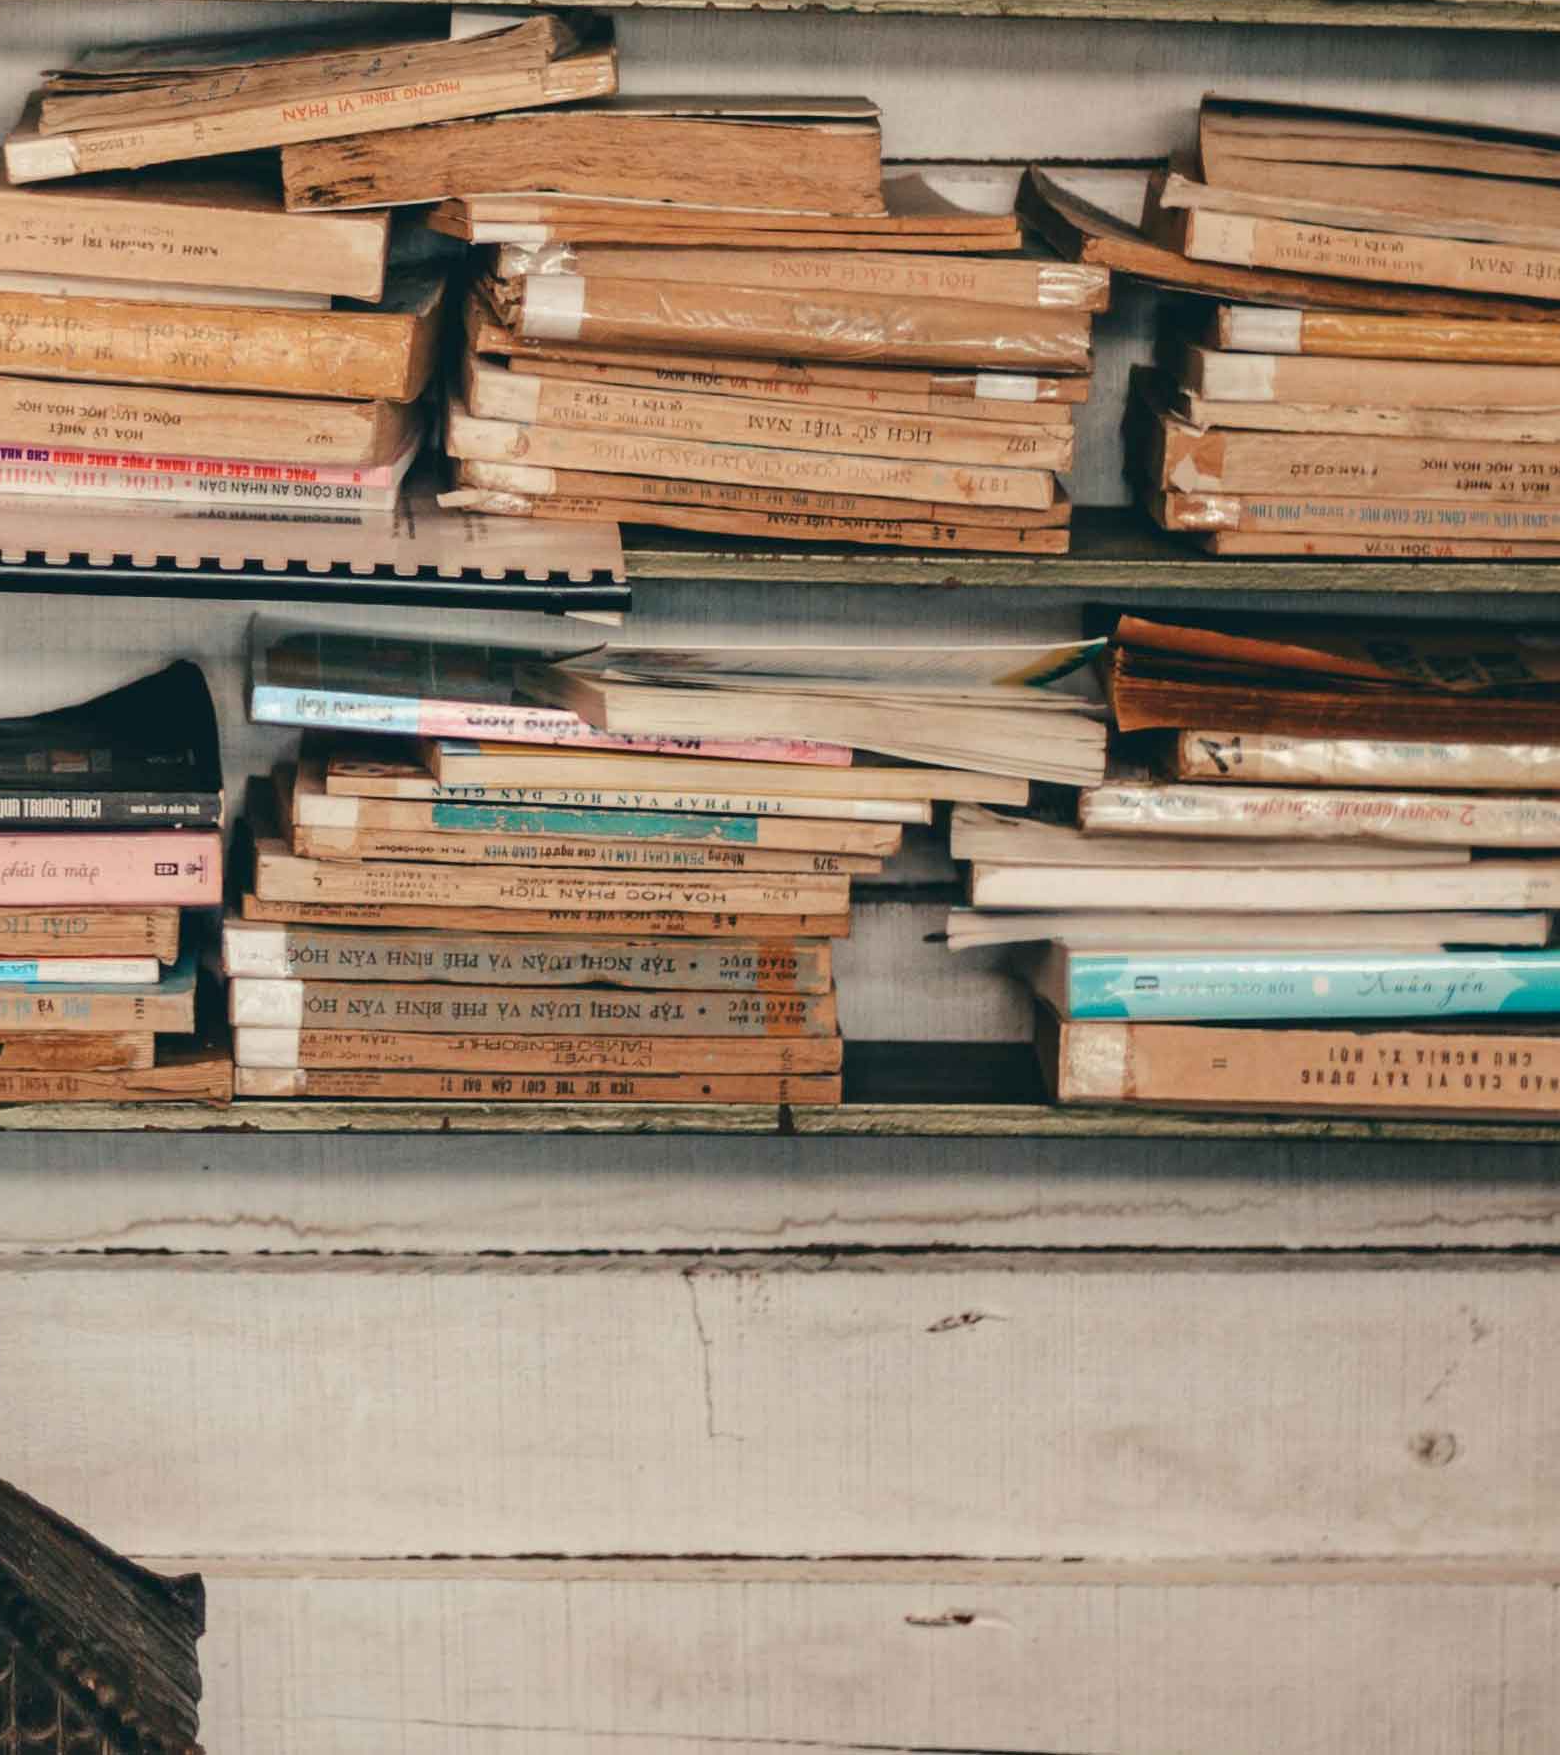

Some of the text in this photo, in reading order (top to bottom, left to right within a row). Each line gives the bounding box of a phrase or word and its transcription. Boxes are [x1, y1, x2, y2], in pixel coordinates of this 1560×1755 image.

[279, 78, 461, 125] PHƯƠNG TRÌNH VI PHÂN
[1466, 254, 1514, 274] NAM
[197, 475, 362, 501] NXB CÔNG AN NHÂN DÂN
[498, 885, 726, 904] HÓA HỌC PHÂN TÍCH
[345, 998, 684, 1023] TẬP NGHỊ LUẬN VÀ PHÊ BÌNH VĂN
